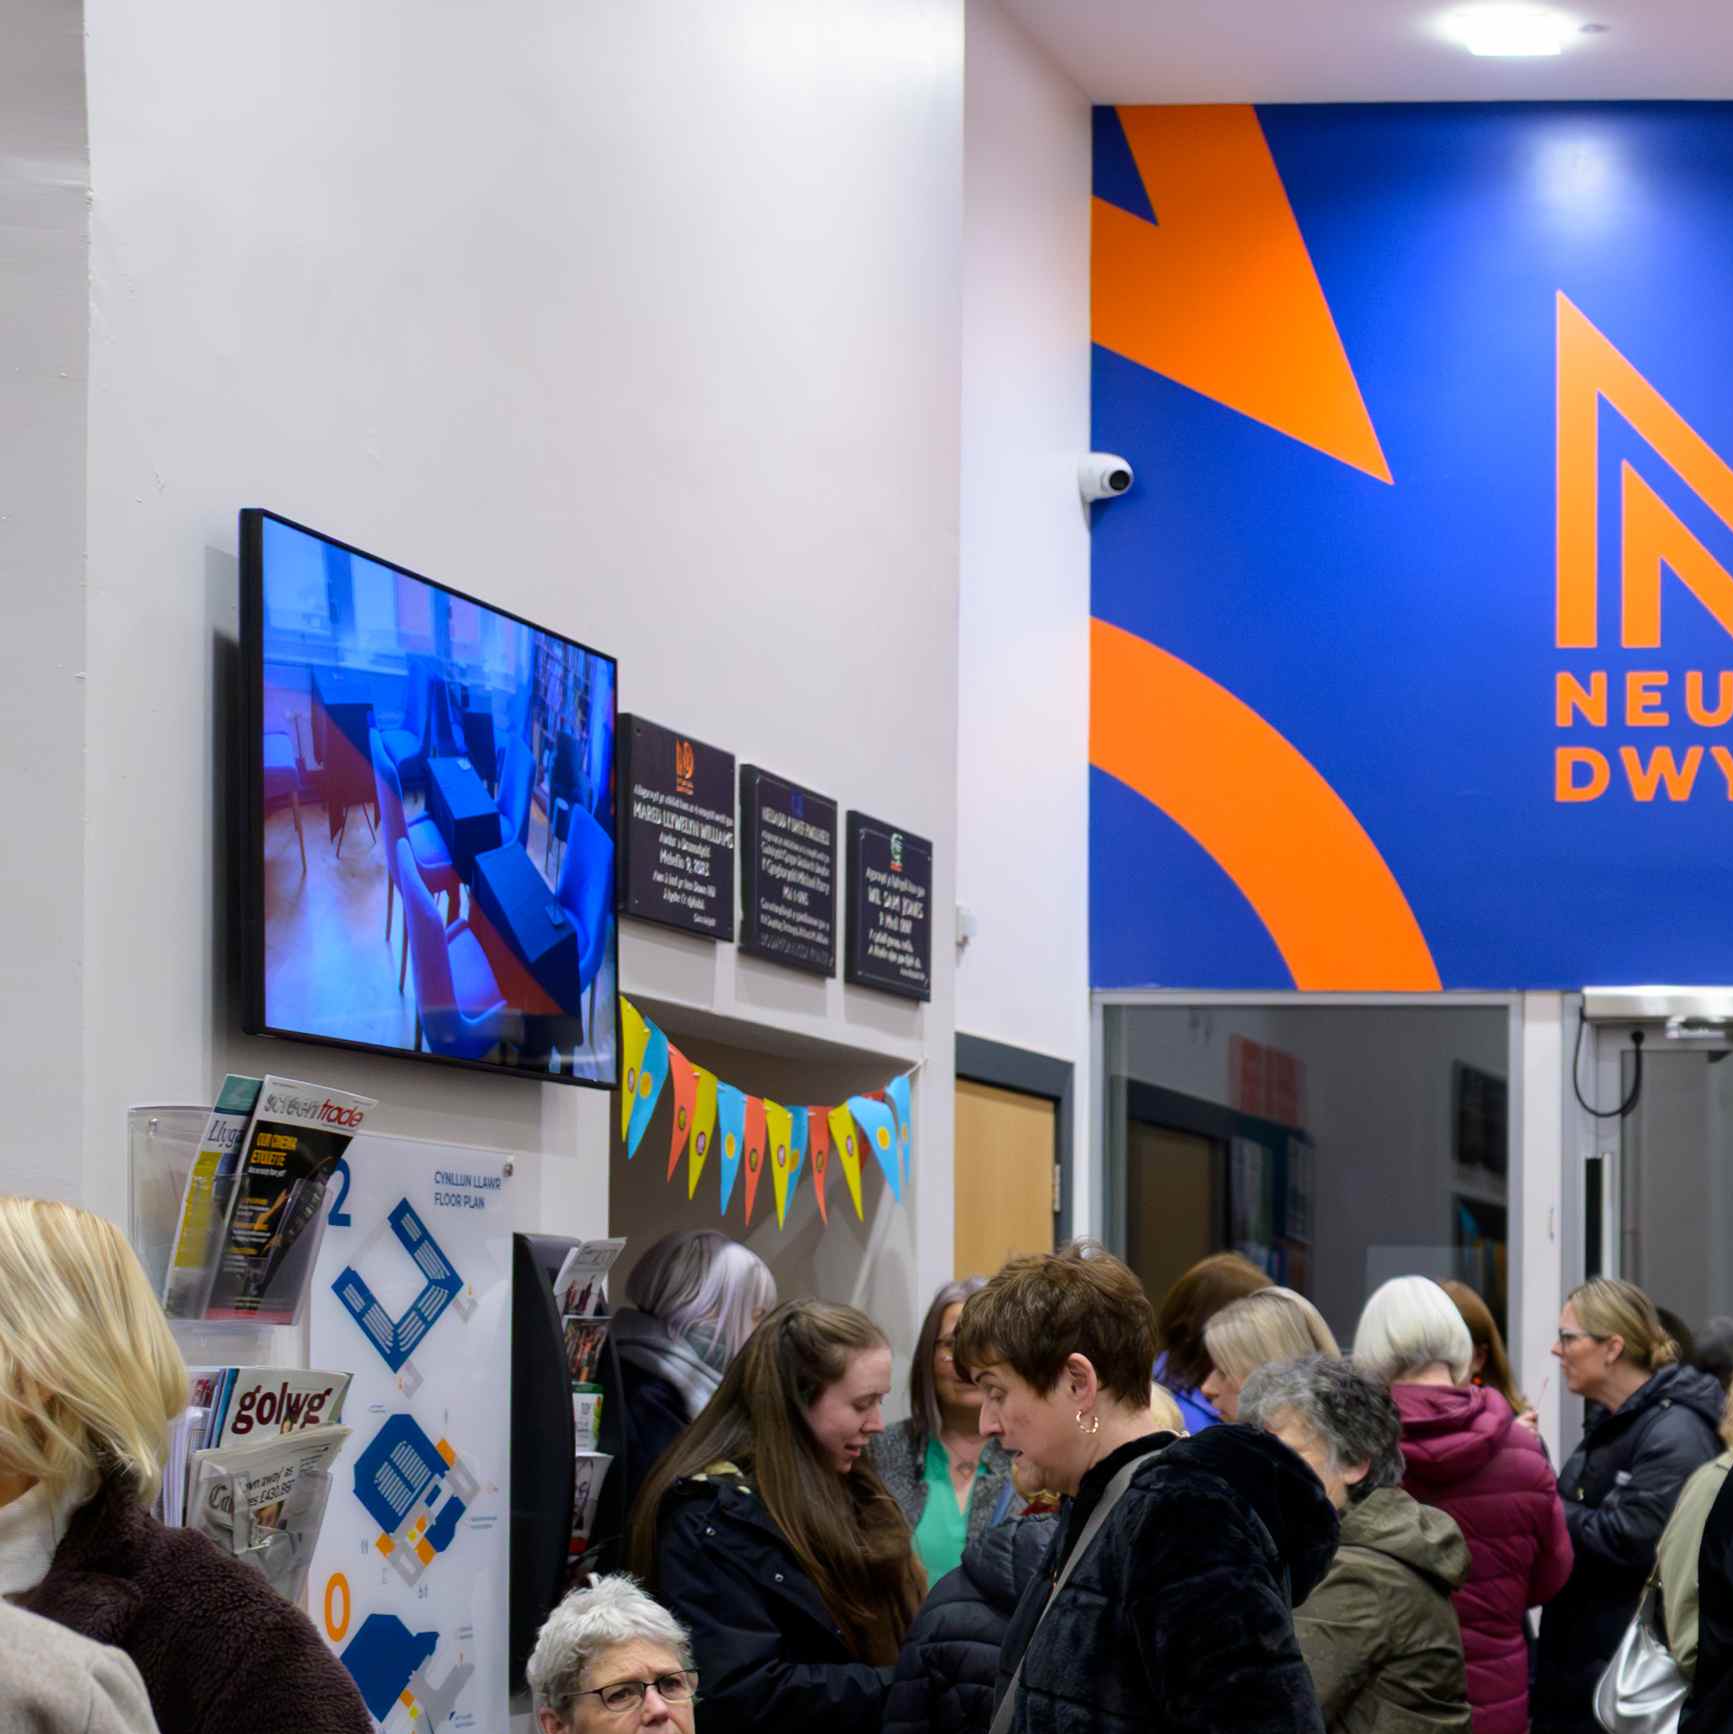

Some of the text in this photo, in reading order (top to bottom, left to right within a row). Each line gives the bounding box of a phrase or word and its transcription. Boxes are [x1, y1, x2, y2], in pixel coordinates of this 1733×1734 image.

[328, 1157, 352, 1227] 2
[433, 1170, 502, 1191] CYNLLUN LLAWR
[433, 1192, 486, 1209] FLOOR PLAN
[231, 1381, 333, 1435] golwg
